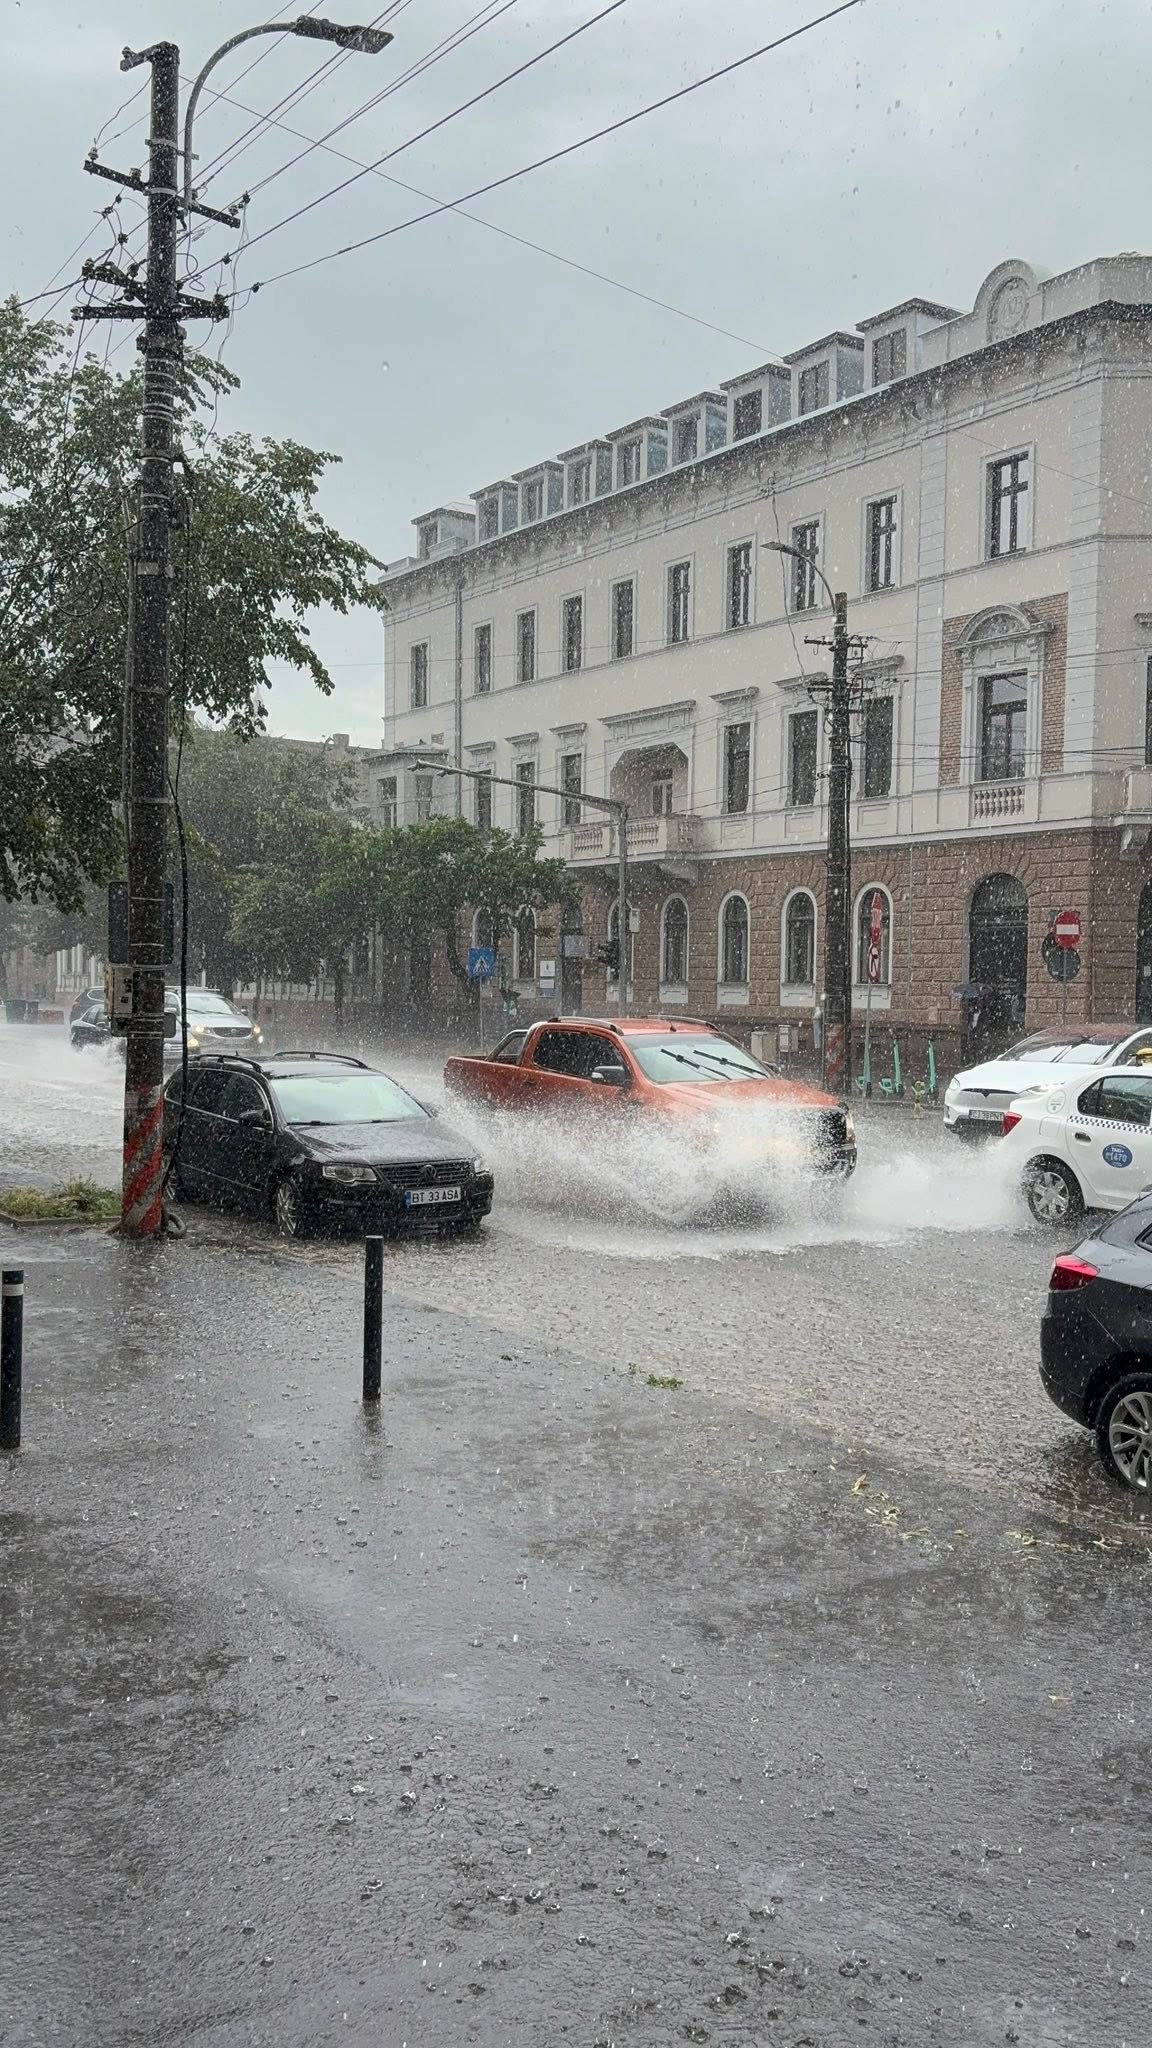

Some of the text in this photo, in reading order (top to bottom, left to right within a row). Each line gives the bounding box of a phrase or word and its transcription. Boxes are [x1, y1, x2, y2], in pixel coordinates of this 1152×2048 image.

[412, 1190, 458, 1203] BT 33 ASA
